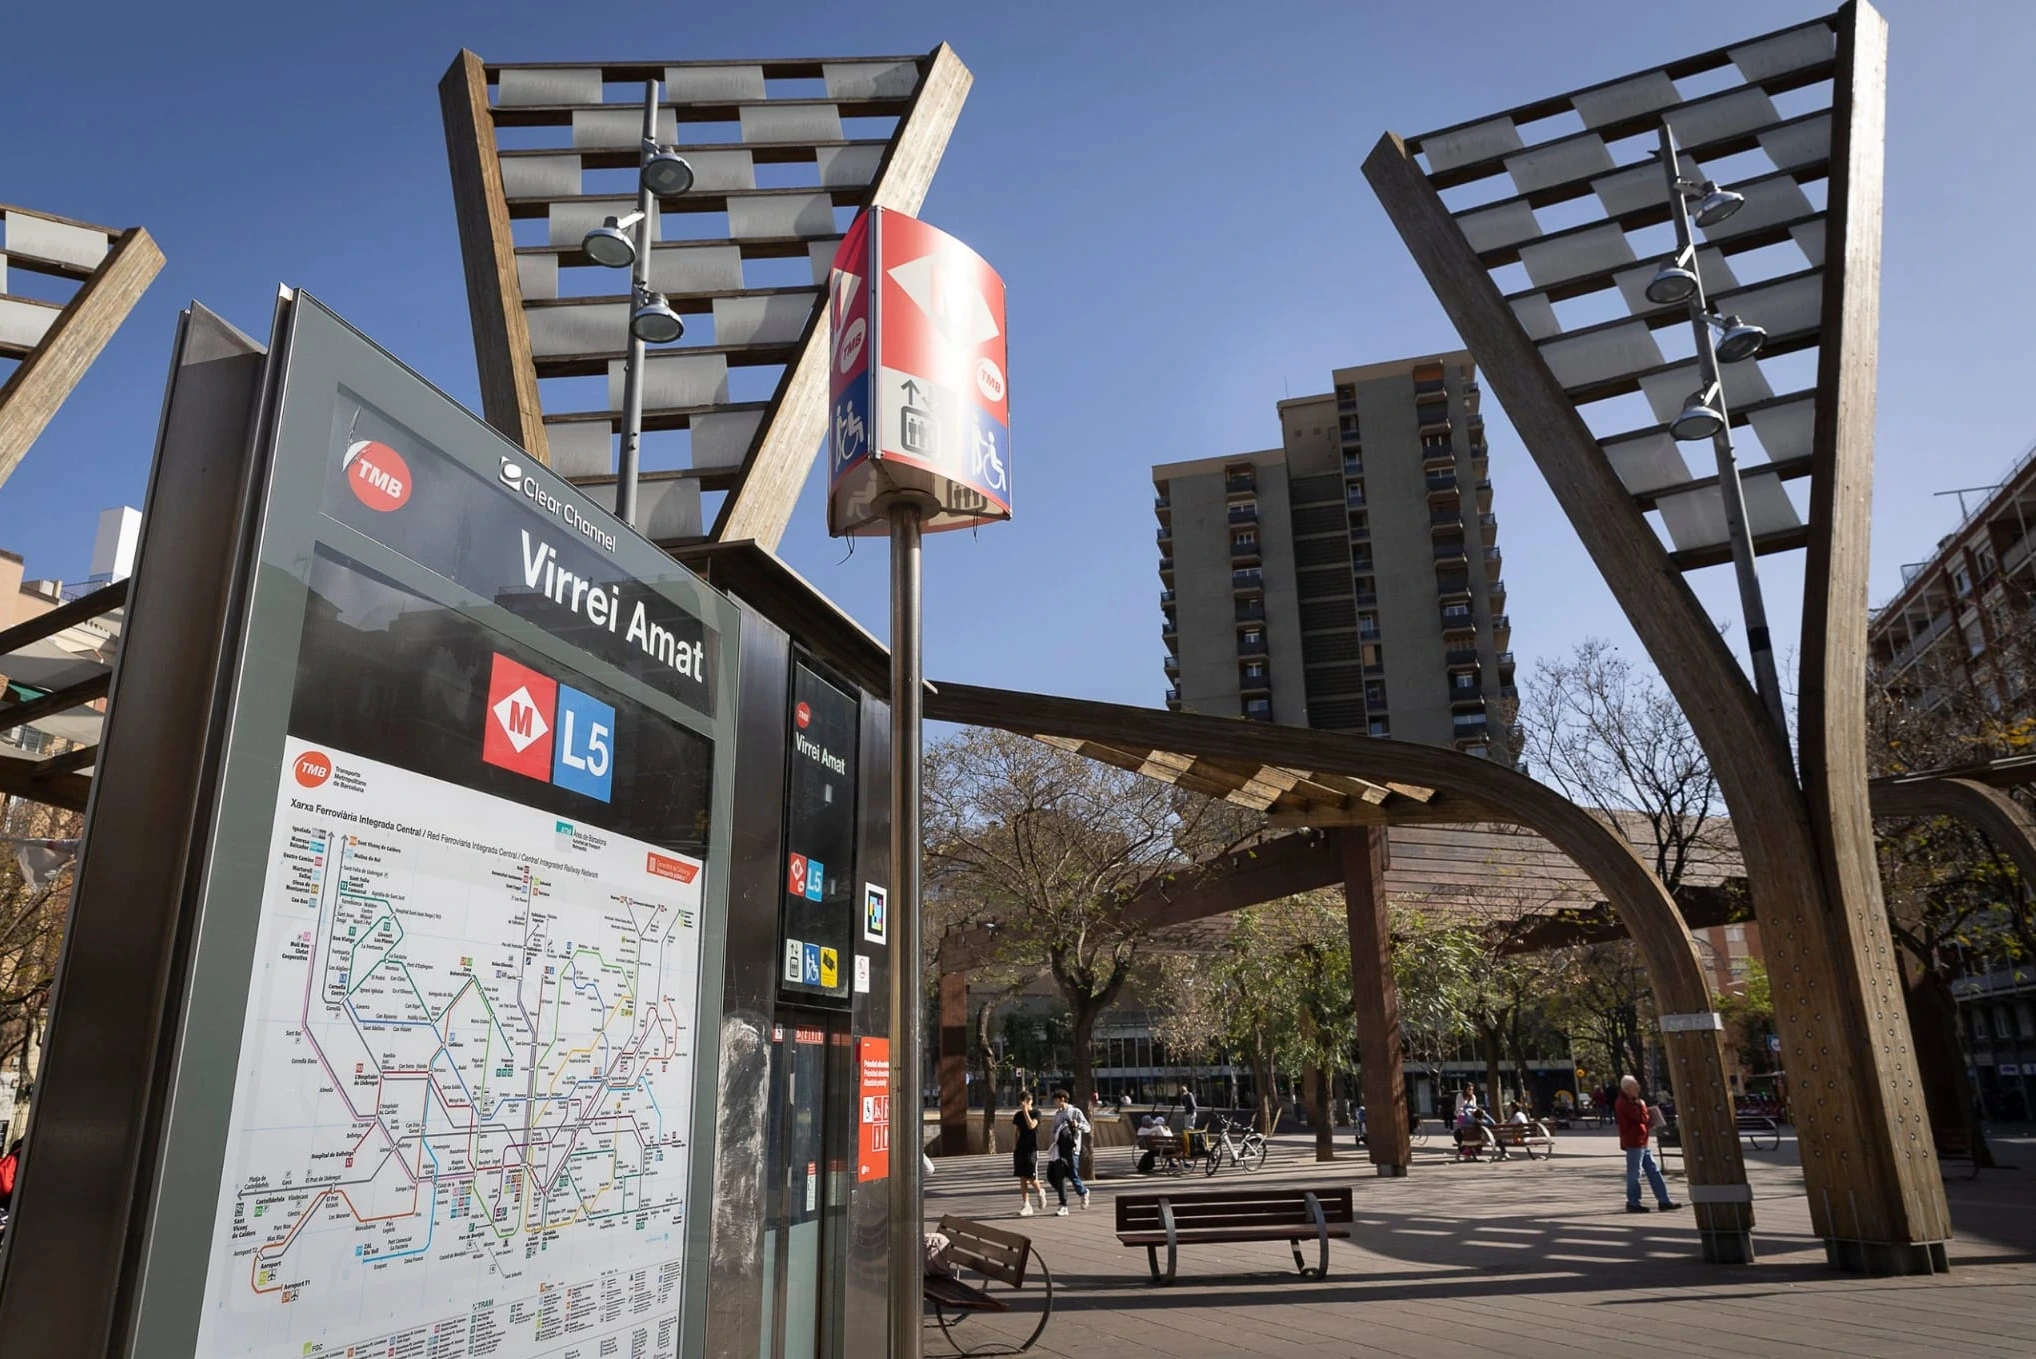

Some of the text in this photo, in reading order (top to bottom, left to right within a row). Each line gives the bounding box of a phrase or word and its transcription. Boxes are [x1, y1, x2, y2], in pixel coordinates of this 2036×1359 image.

[982, 368, 1000, 394] TMB
[359, 458, 402, 498] TMB
[523, 477, 615, 552] Clear Channel
[522, 529, 704, 683] Virrei Amat
[508, 701, 609, 777] M L5
[796, 732, 845, 775] Virrei Amat
[302, 762, 328, 778] TMB
[290, 798, 314, 812] Xarxa
[316, 804, 358, 822] Ferroviària
[360, 814, 394, 830] Integrada
[396, 823, 421, 837] Central
[427, 830, 440, 841] Red
[441, 834, 471, 848] Ferroviaria
[472, 841, 498, 854] Integrada
[498, 848, 518, 860] Central
[521, 853, 540, 864] Central
[540, 858, 564, 871] Integrated
[564, 864, 581, 876] Railway
[582, 868, 598, 879] Network
[808, 868, 822, 892] L5
[261, 1261, 282, 1269] Aeroport
[284, 1281, 304, 1290] Aeroport
[478, 1298, 494, 1309] TRAM
[312, 1344, 323, 1352] FGC
